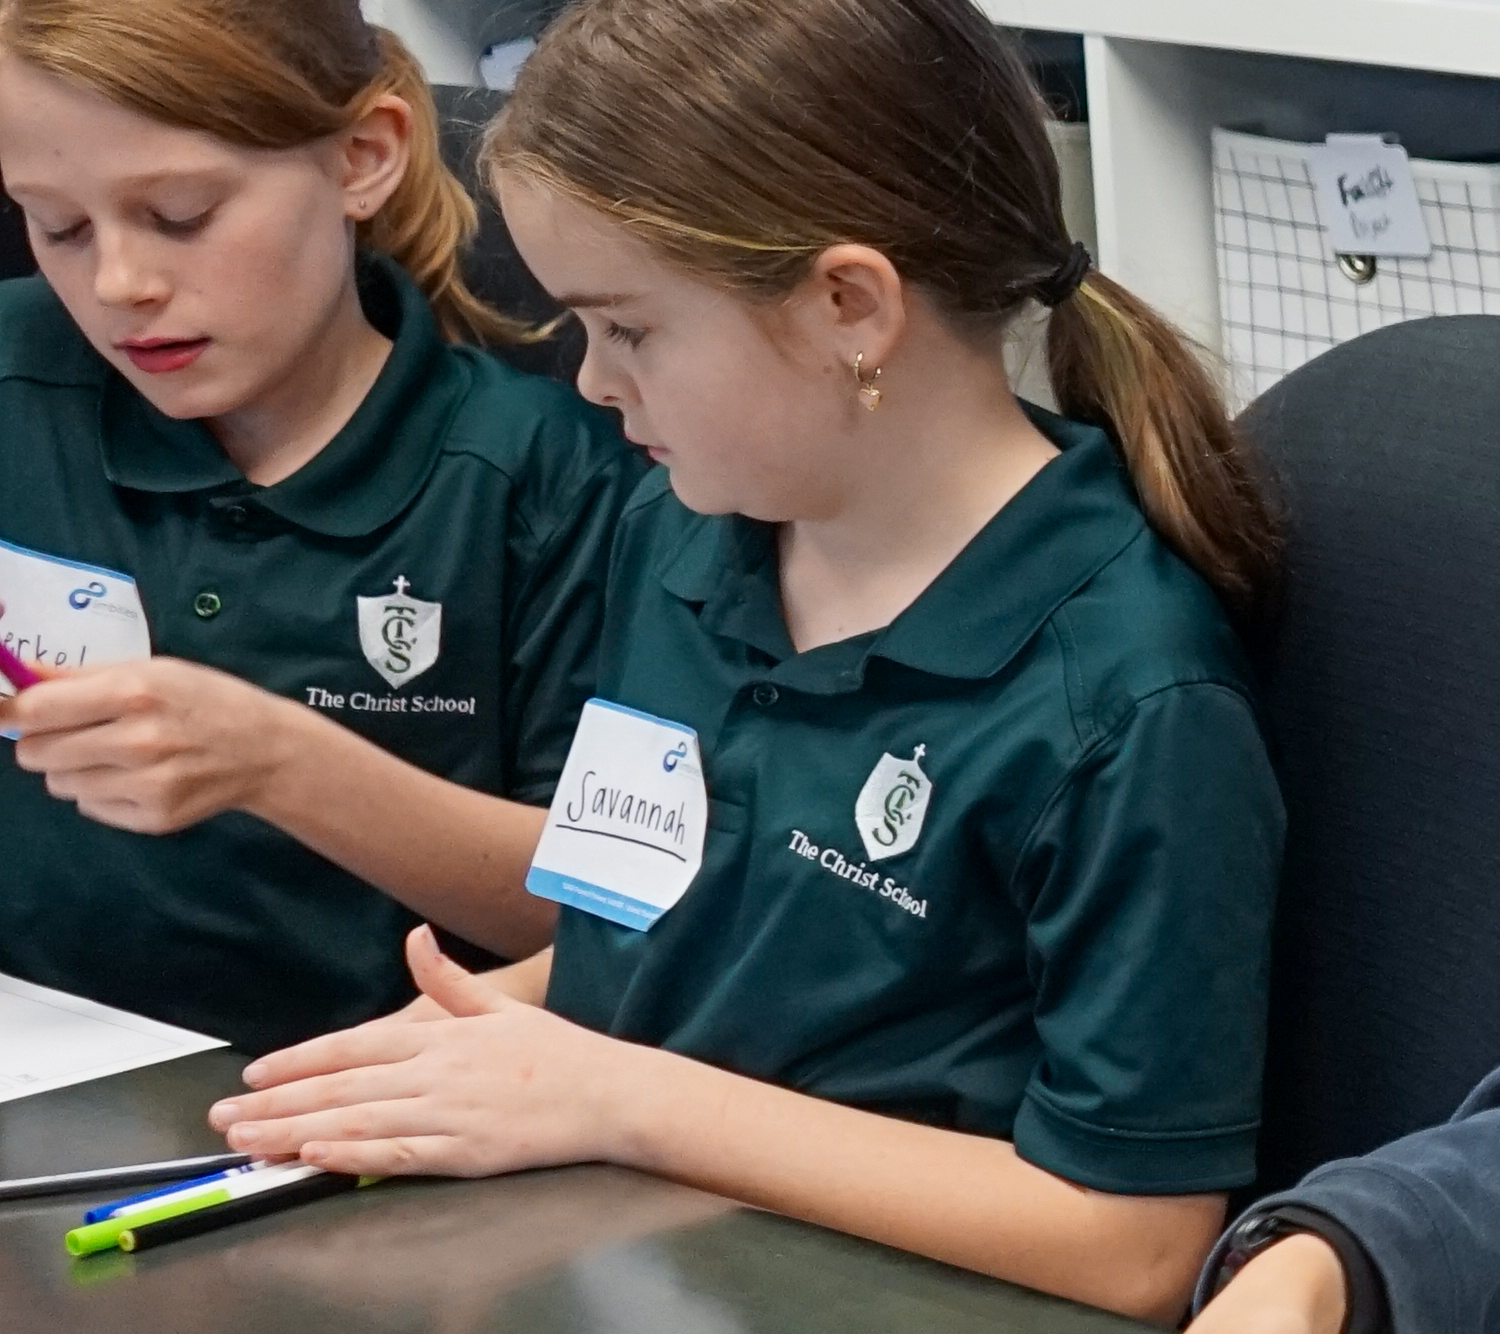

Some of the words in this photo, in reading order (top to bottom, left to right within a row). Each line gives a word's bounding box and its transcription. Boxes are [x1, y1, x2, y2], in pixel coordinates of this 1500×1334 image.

[306, 686, 346, 711] The
[349, 691, 408, 714] Christ
[411, 695, 477, 716] School
[567, 770, 687, 847] Savannah
[788, 829, 820, 861] The
[819, 847, 880, 893] Christ
[878, 877, 928, 919] School
